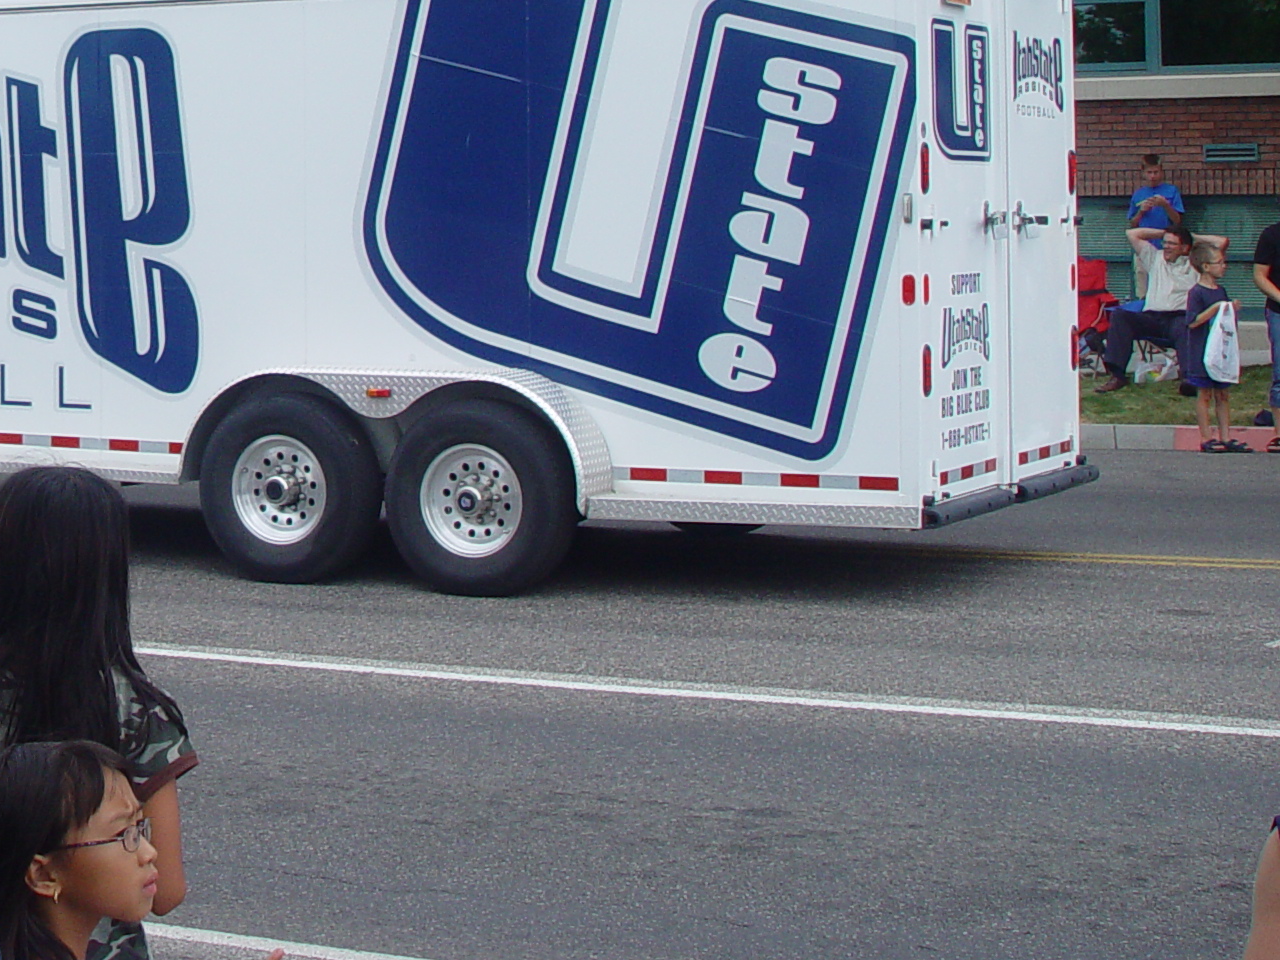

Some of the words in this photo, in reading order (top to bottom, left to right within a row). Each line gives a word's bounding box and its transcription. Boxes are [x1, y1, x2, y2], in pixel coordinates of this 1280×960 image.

[1016, 103, 1055, 119] FOOTBALL
[951, 272, 981, 295] SUPPORT
[952, 368, 968, 391] JOIN
[970, 365, 981, 387] THE
[942, 396, 954, 418] BIG
[957, 392, 972, 415] BLUE
[975, 389, 989, 411] CLUB
